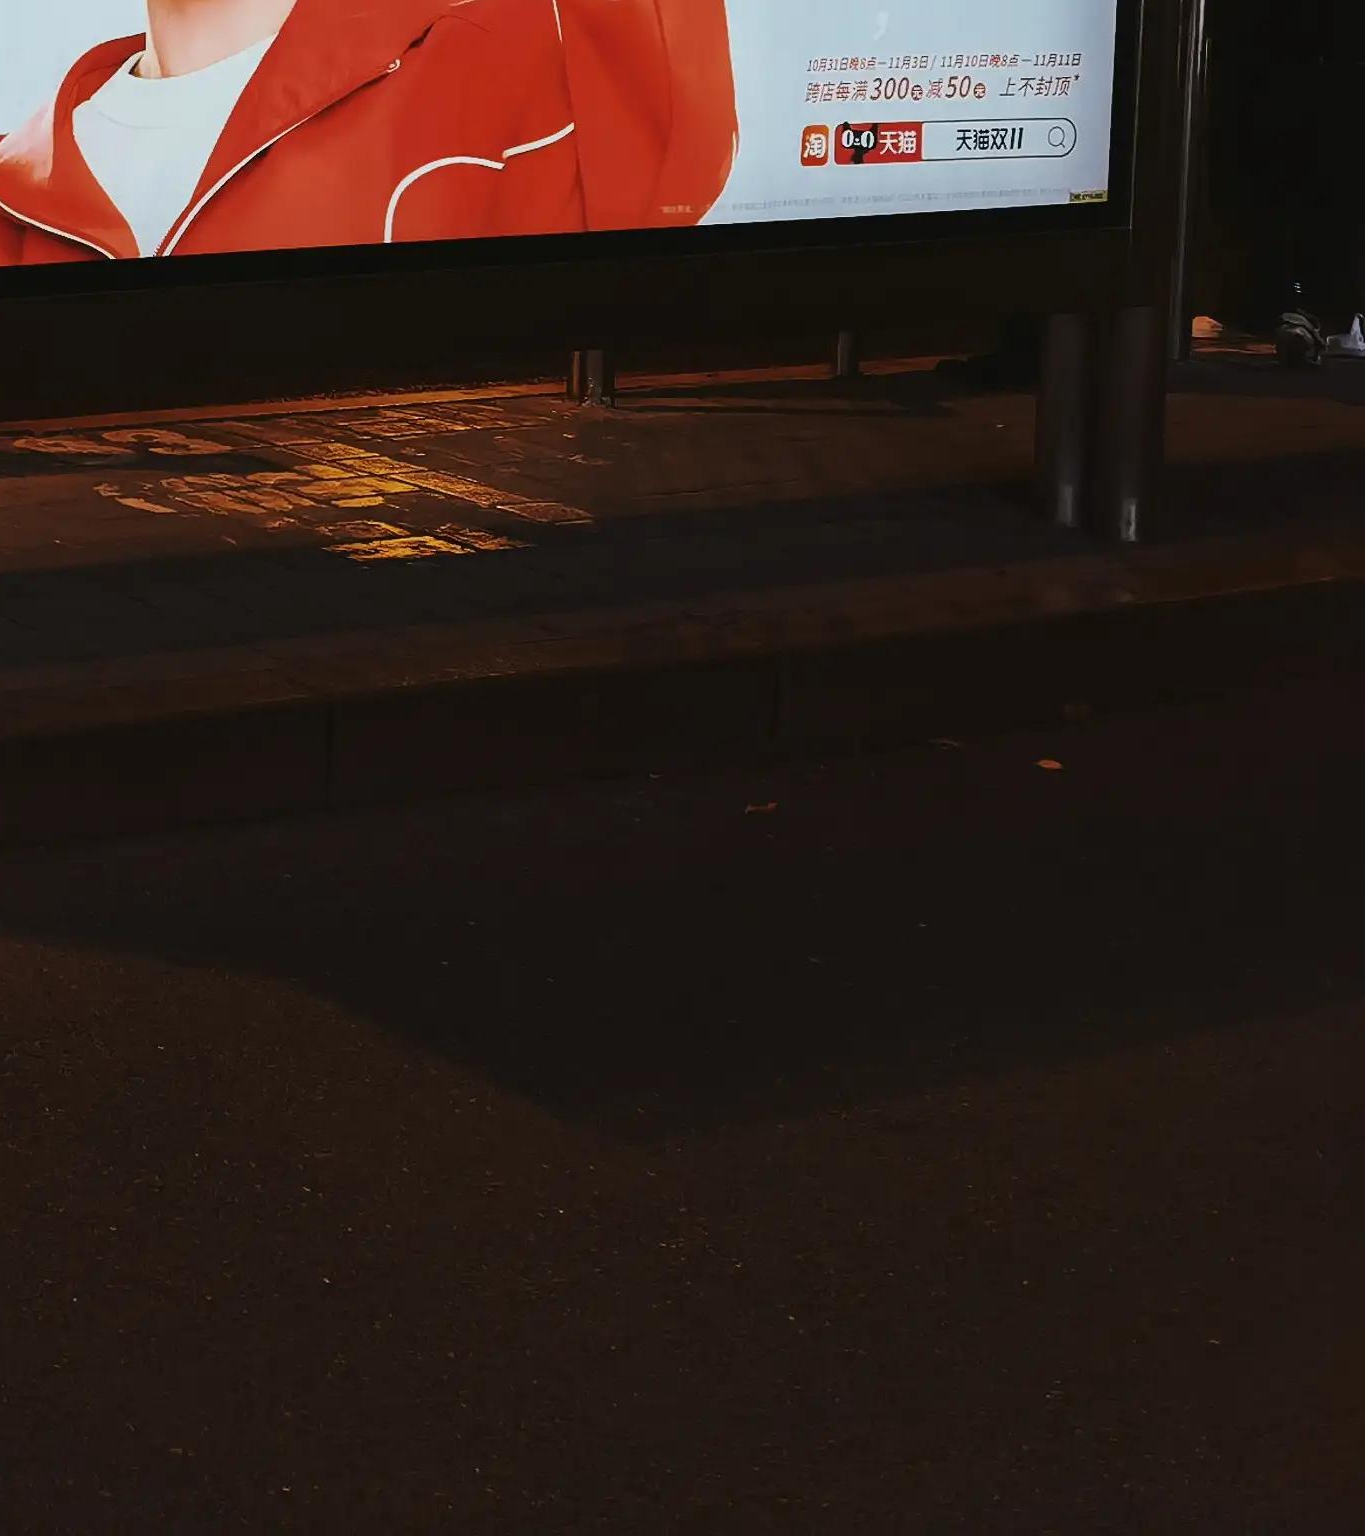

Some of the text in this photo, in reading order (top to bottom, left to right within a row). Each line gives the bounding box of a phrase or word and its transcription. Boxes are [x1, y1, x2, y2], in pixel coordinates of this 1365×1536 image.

[802, 127, 1025, 160] 淘 天猫 天猫双11
